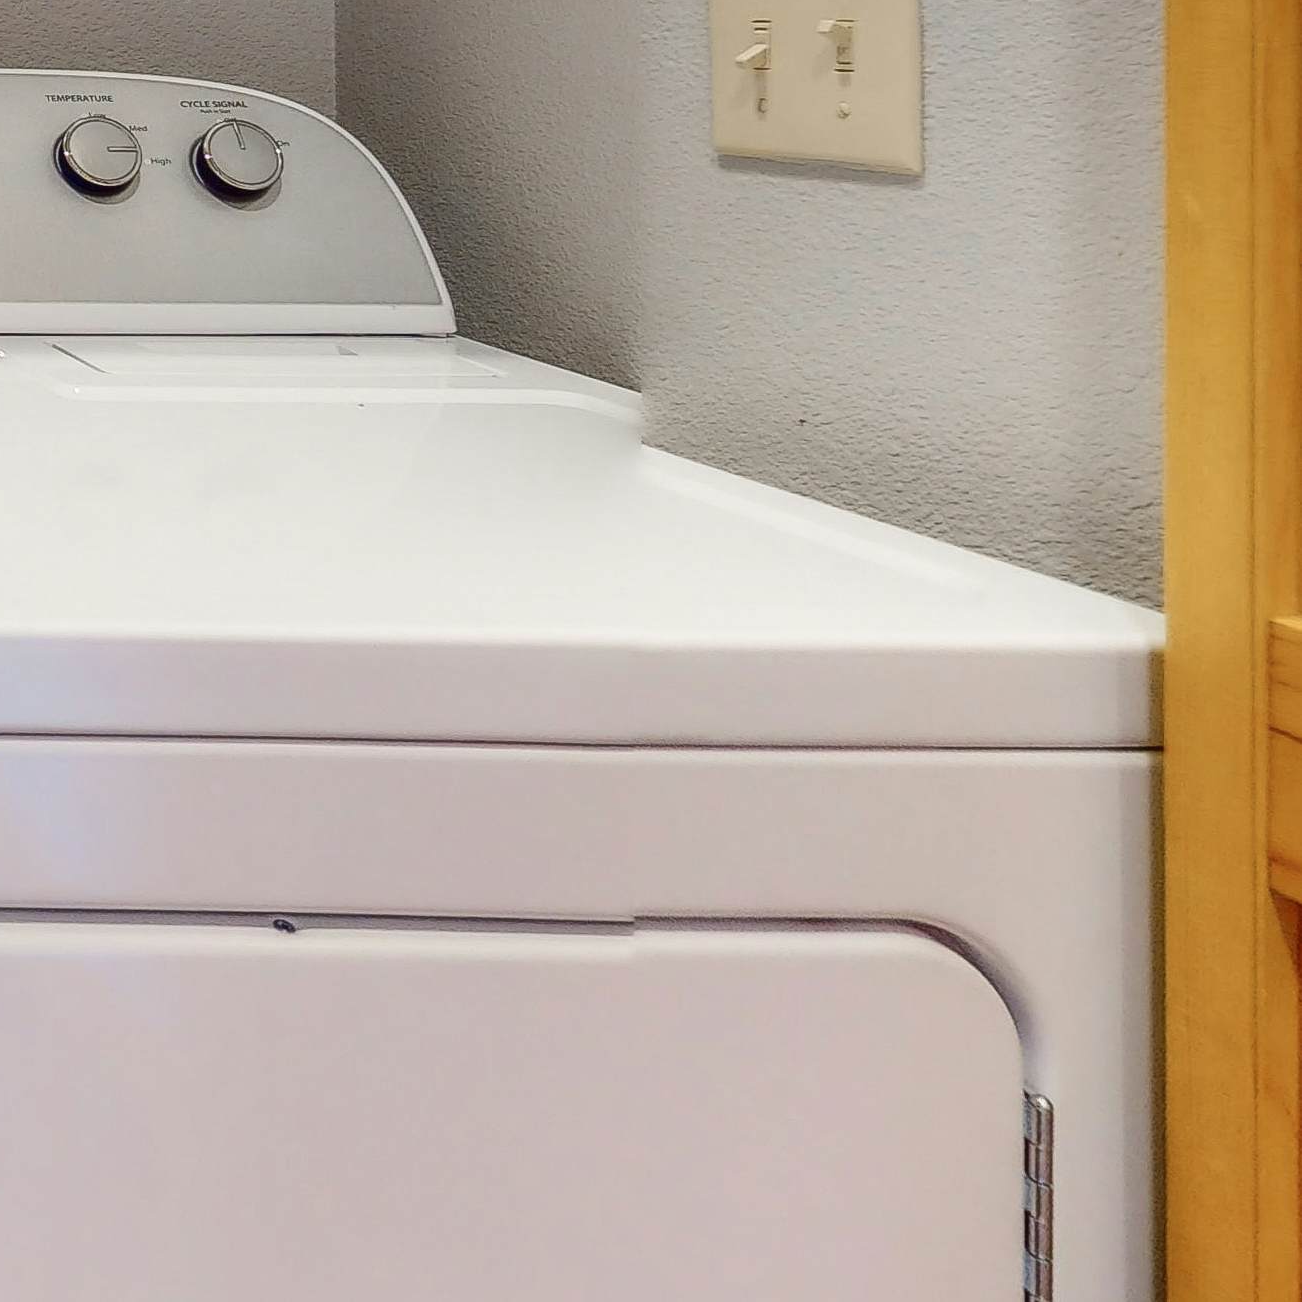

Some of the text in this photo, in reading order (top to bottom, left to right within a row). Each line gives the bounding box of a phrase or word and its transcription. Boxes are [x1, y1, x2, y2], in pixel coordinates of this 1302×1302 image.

[44, 94, 114, 102] TEMPERATURE
[180, 100, 248, 108] CYCLE SIGNAL
[150, 158, 172, 166] High
